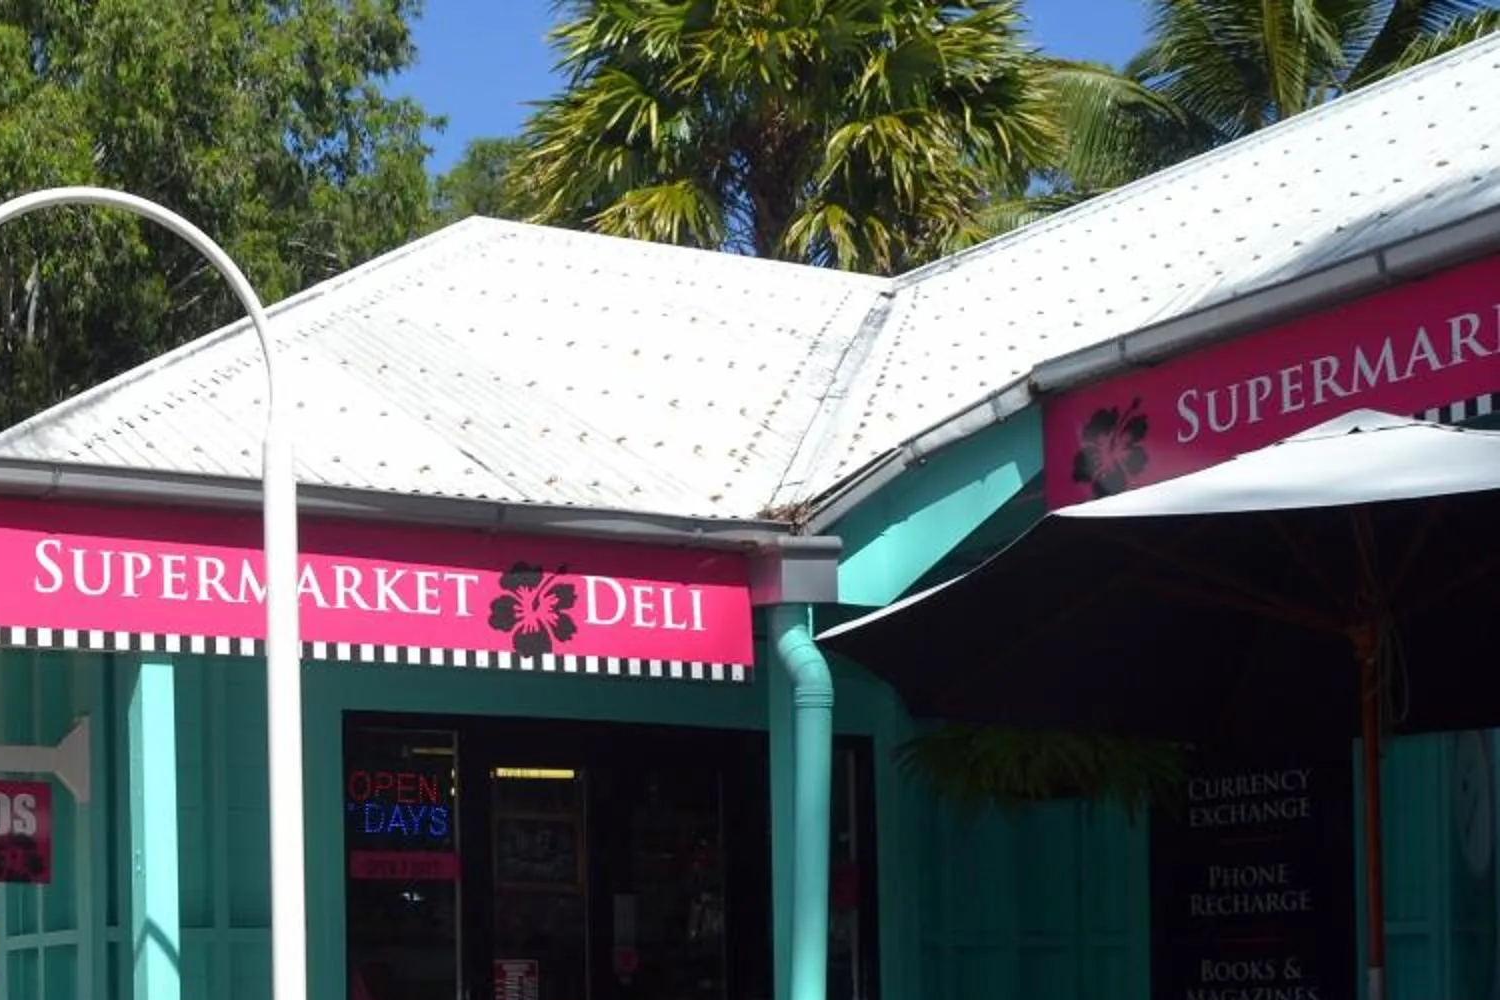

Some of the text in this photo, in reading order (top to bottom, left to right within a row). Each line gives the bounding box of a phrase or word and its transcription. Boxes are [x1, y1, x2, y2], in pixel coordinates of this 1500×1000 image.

[1176, 303, 1500, 444] SUPERMAR
[34, 539, 706, 631] SUPERMARKET DELI
[348, 769, 439, 804] OPEN
[1188, 768, 1312, 800] CURRENCY
[363, 800, 450, 838] DAYS
[1189, 797, 1312, 828] EXCHANGE
[1209, 864, 1290, 889] PHONE
[1190, 890, 1313, 917] RECHARGE
[1200, 957, 1303, 982] BOOKS &
